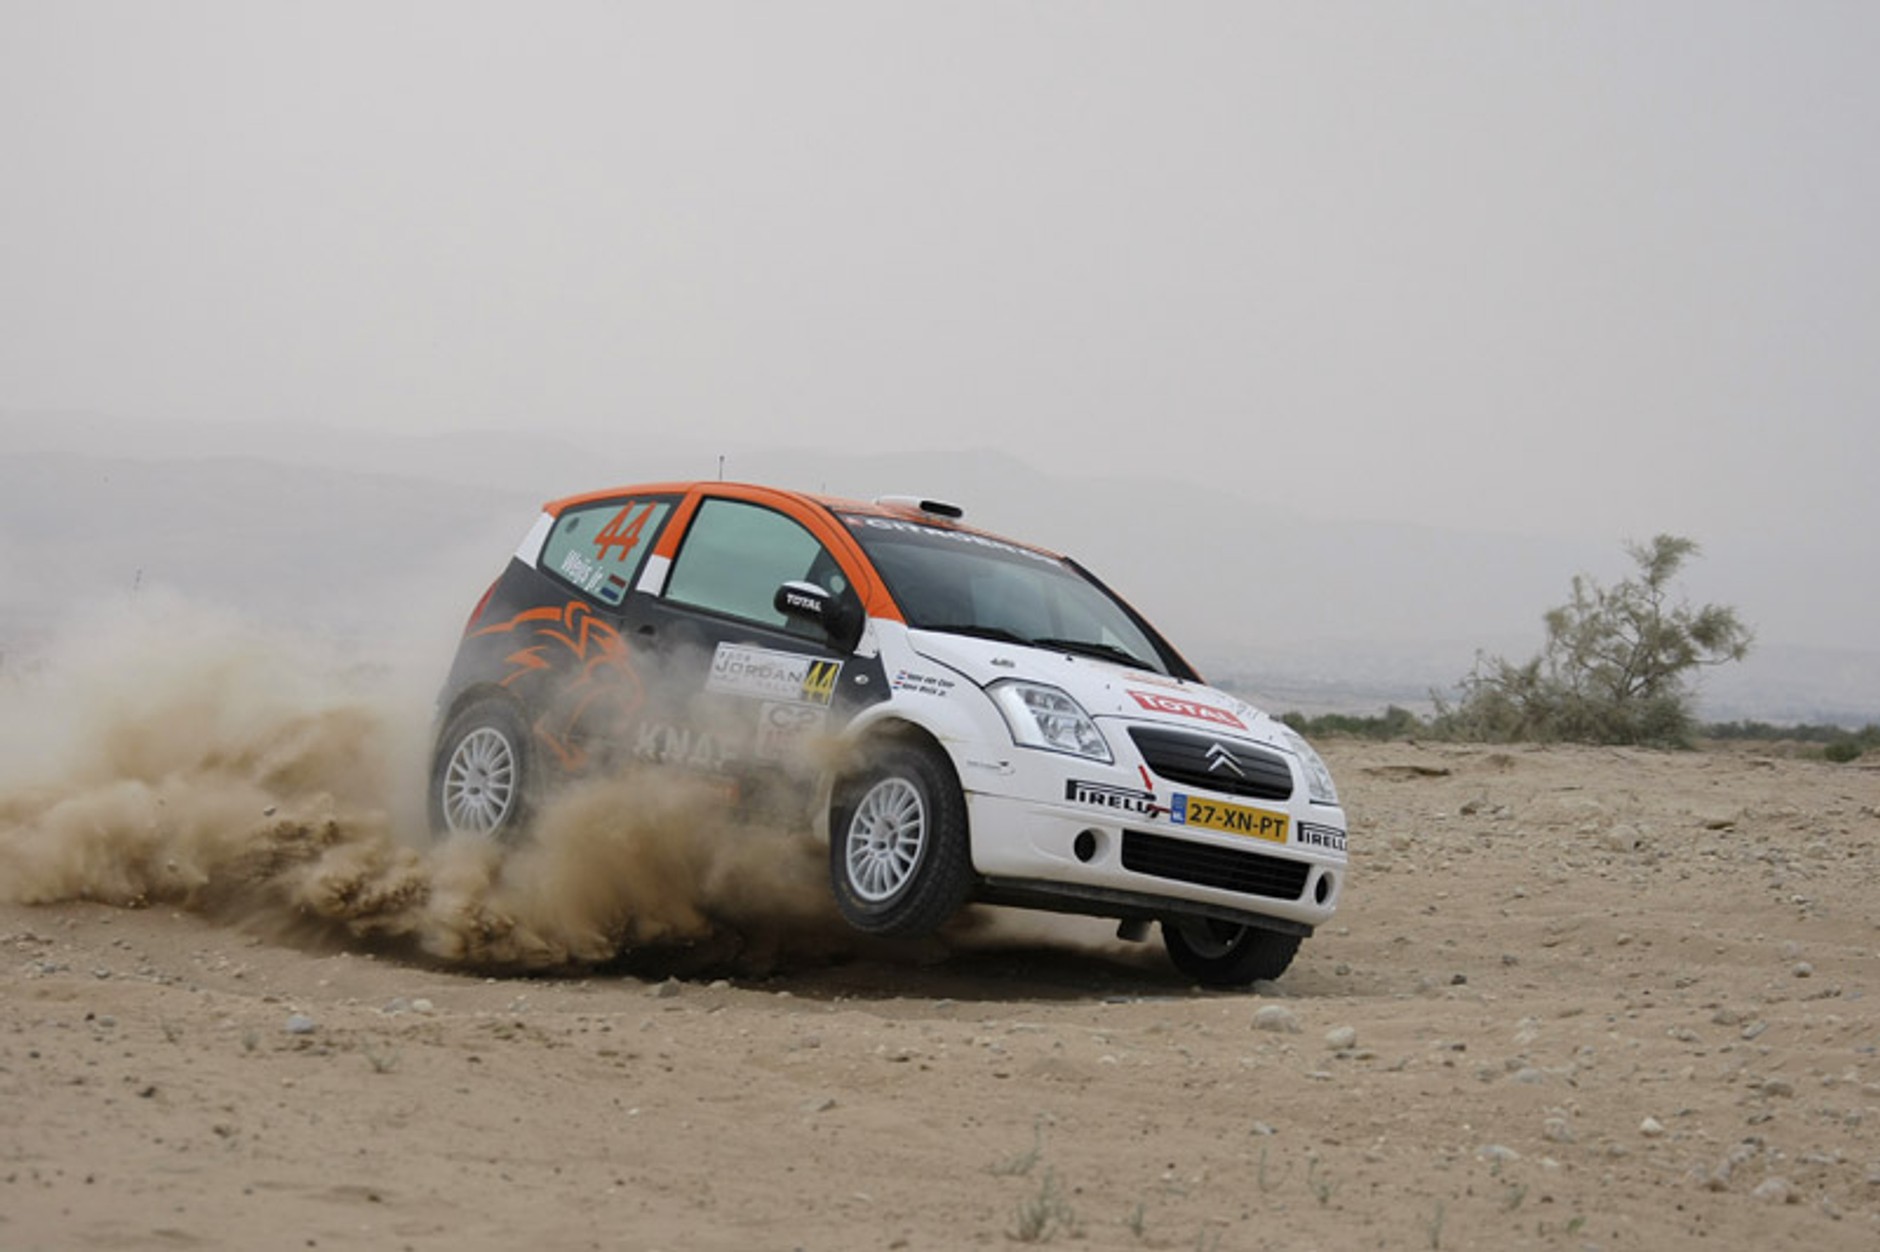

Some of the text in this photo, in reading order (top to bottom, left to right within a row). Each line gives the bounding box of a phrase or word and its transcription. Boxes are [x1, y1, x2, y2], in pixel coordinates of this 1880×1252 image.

[593, 500, 657, 562] 44
[786, 593, 822, 612] TOTAL
[715, 660, 802, 683] JORDAN
[804, 660, 840, 706] 44
[1131, 691, 1244, 728] TOTAL
[1189, 803, 1285, 838] 27-XN-PT
[1297, 820, 1347, 851] PIRELL
